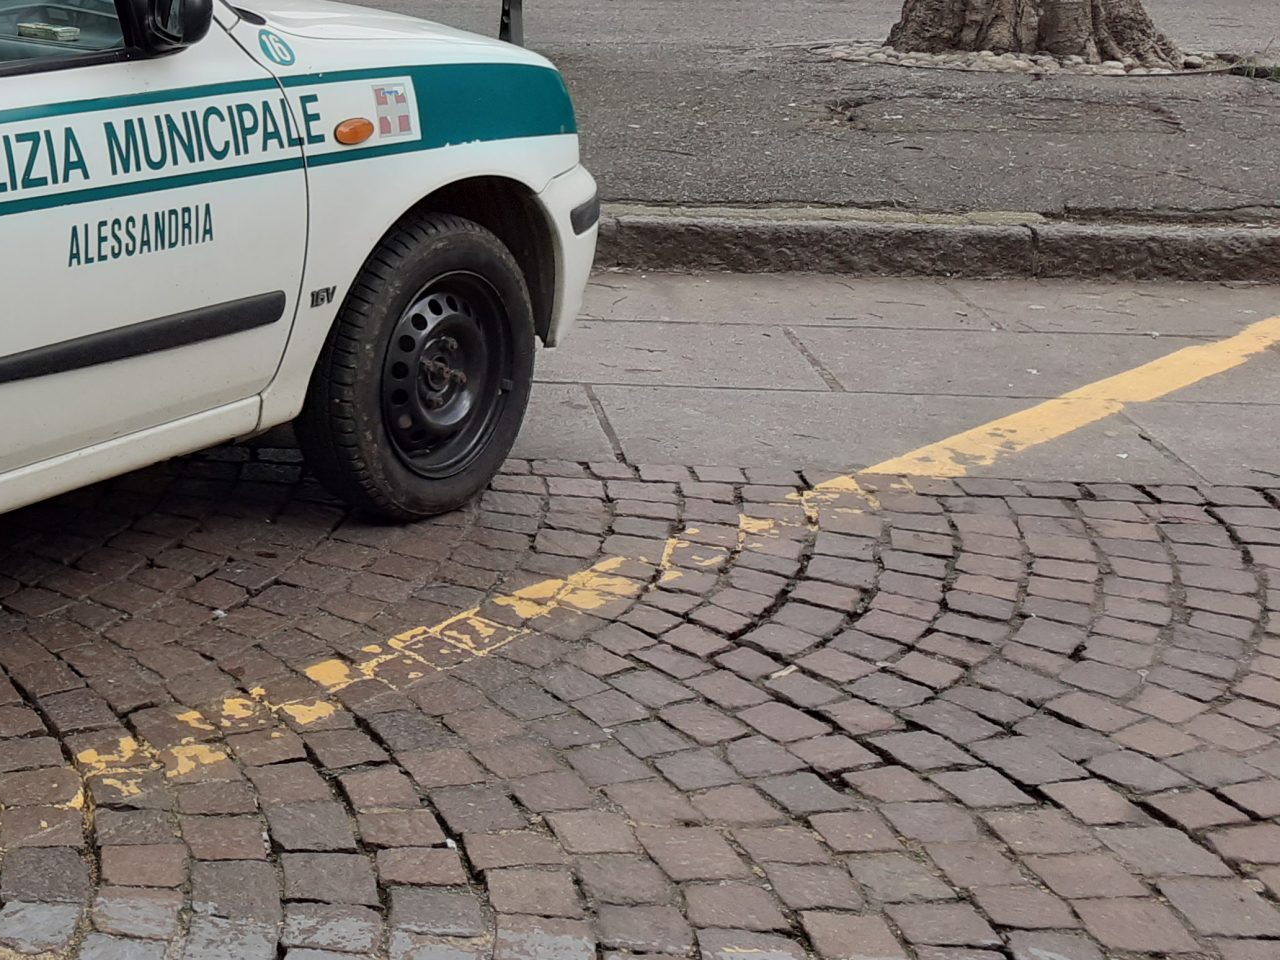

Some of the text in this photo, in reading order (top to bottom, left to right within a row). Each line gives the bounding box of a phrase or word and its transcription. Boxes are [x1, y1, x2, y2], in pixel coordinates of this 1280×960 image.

[261, 33, 291, 62] 16
[104, 94, 325, 176] MUNICIPALE
[68, 203, 214, 268] ALESSANDRIA
[310, 286, 337, 309] 16V
